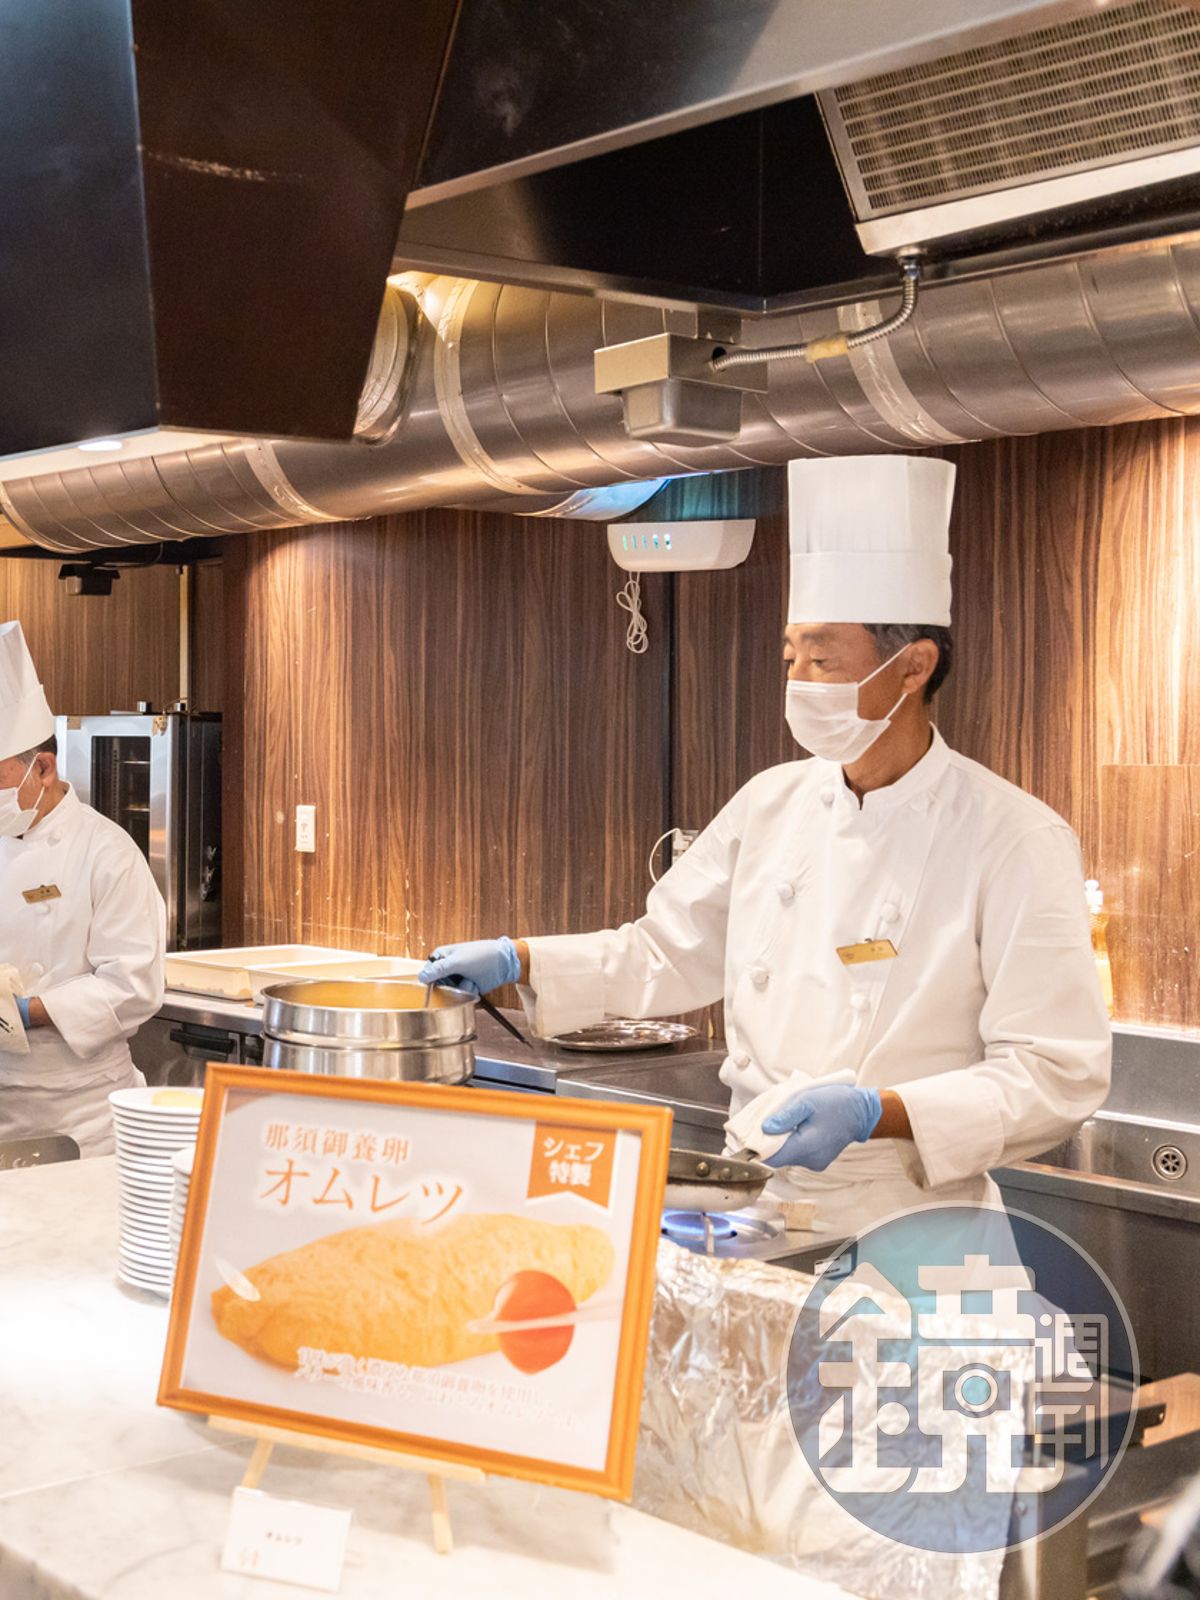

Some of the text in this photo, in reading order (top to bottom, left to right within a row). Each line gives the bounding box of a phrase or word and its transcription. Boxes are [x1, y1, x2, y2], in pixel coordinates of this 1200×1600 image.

[265, 1123, 409, 1164] 那須御養卵
[543, 1136, 604, 1162] シェフ
[259, 1157, 463, 1225] オムレツ
